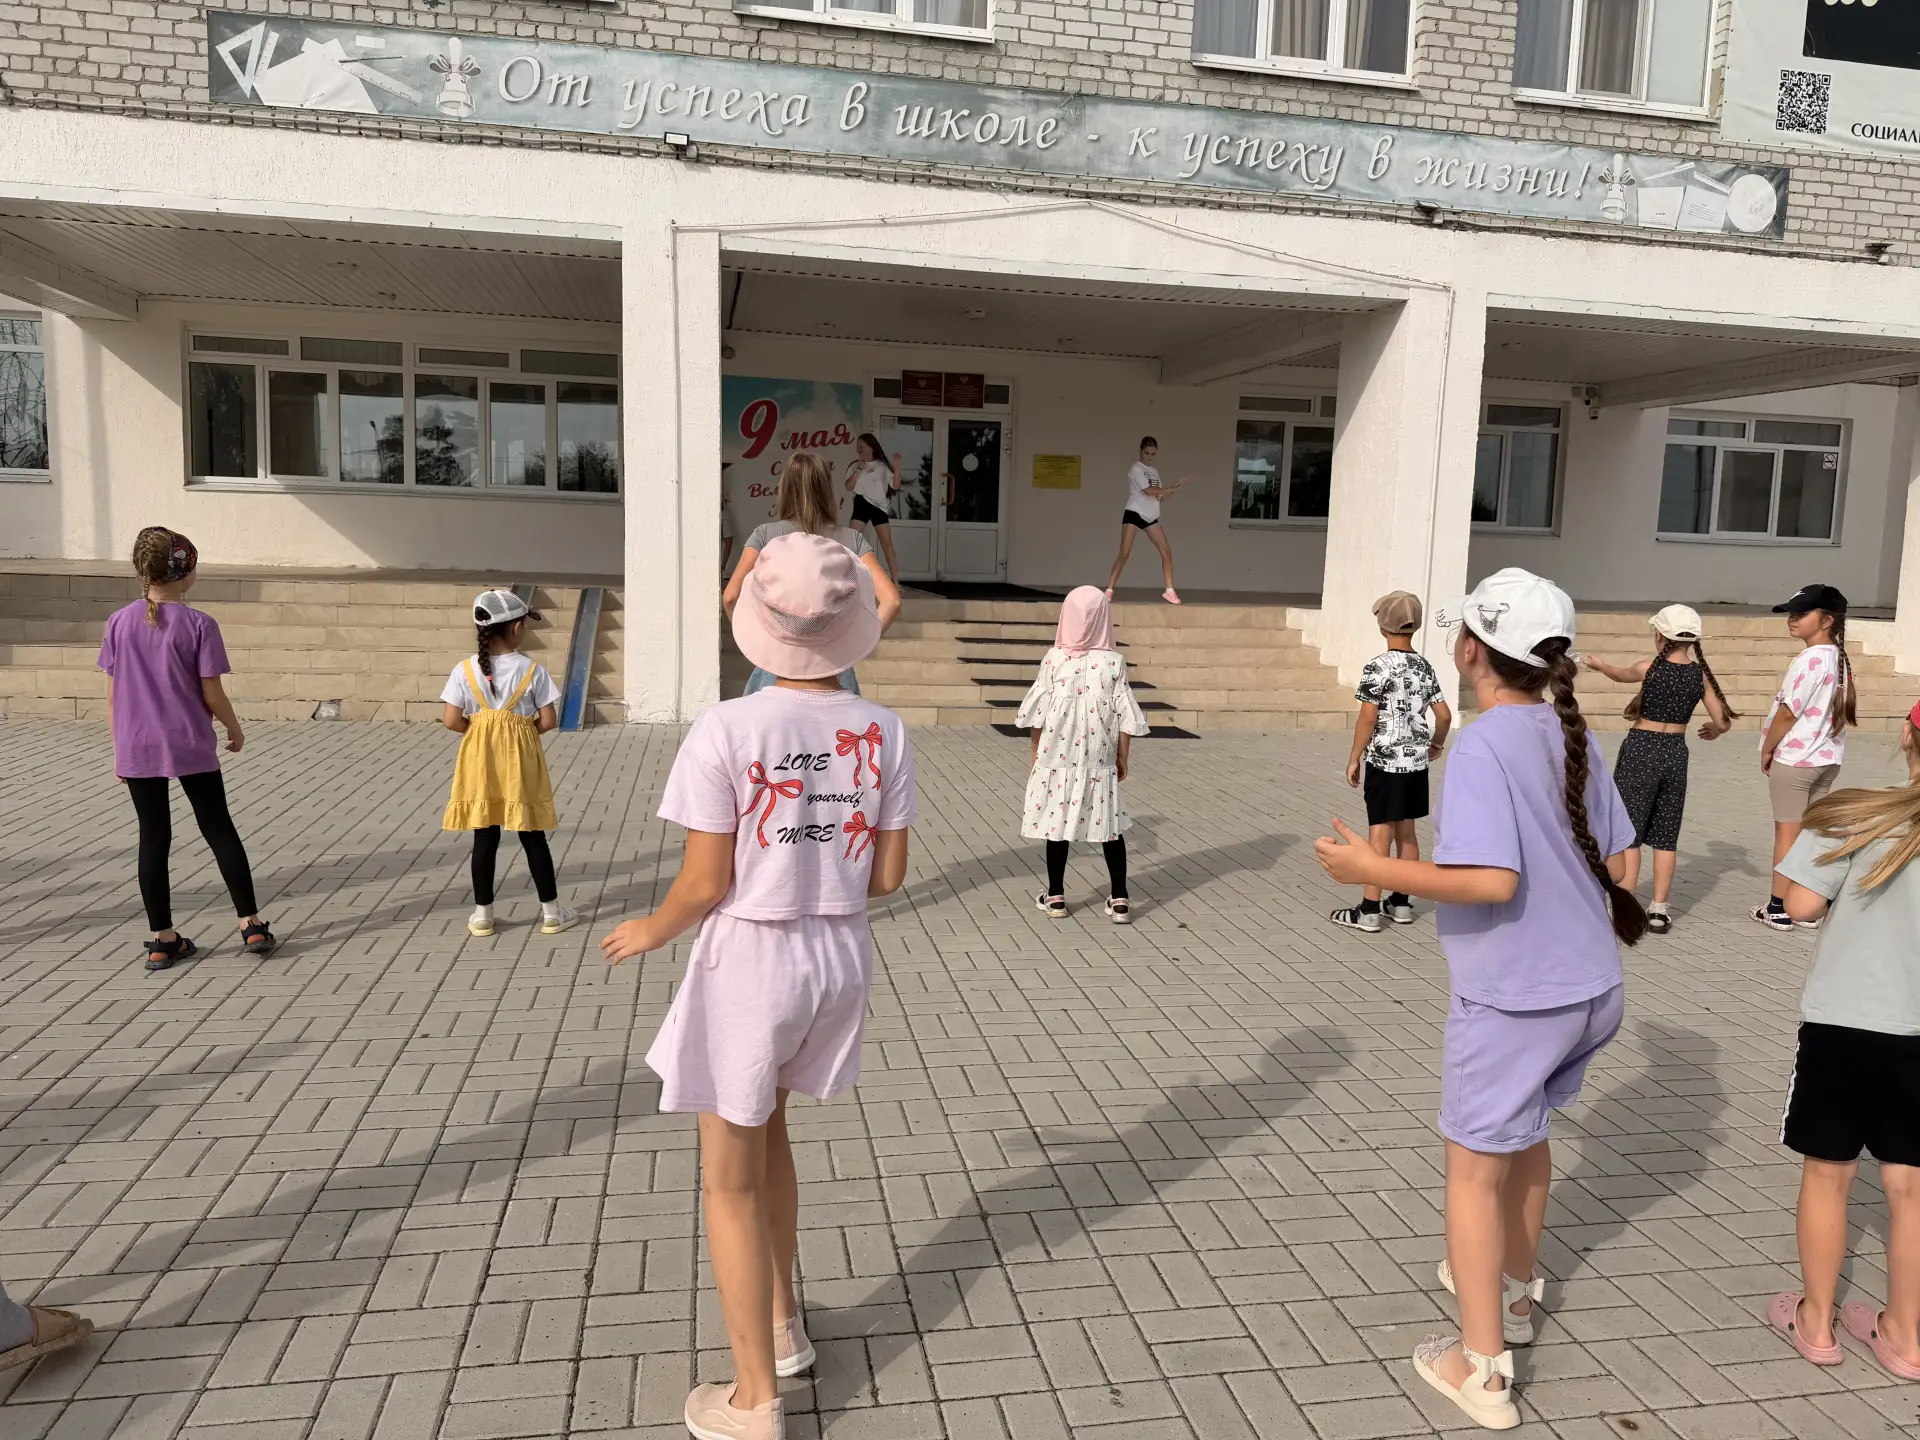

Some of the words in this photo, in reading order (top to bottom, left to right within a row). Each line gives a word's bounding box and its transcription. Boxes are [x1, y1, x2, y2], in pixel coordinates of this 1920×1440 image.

[498, 56, 592, 108] От
[617, 78, 811, 136] успеха
[838, 80, 869, 131] в
[894, 101, 1059, 150] школе
[1127, 124, 1159, 158] к
[1177, 131, 1345, 190] успеху
[1366, 134, 1396, 181] в
[1413, 160, 1592, 200] жизни!
[739, 398, 779, 459] 9
[780, 423, 856, 451] мая
[773, 753, 831, 772] LOVE
[806, 791, 864, 809] yourself
[776, 823, 836, 845] MRE
